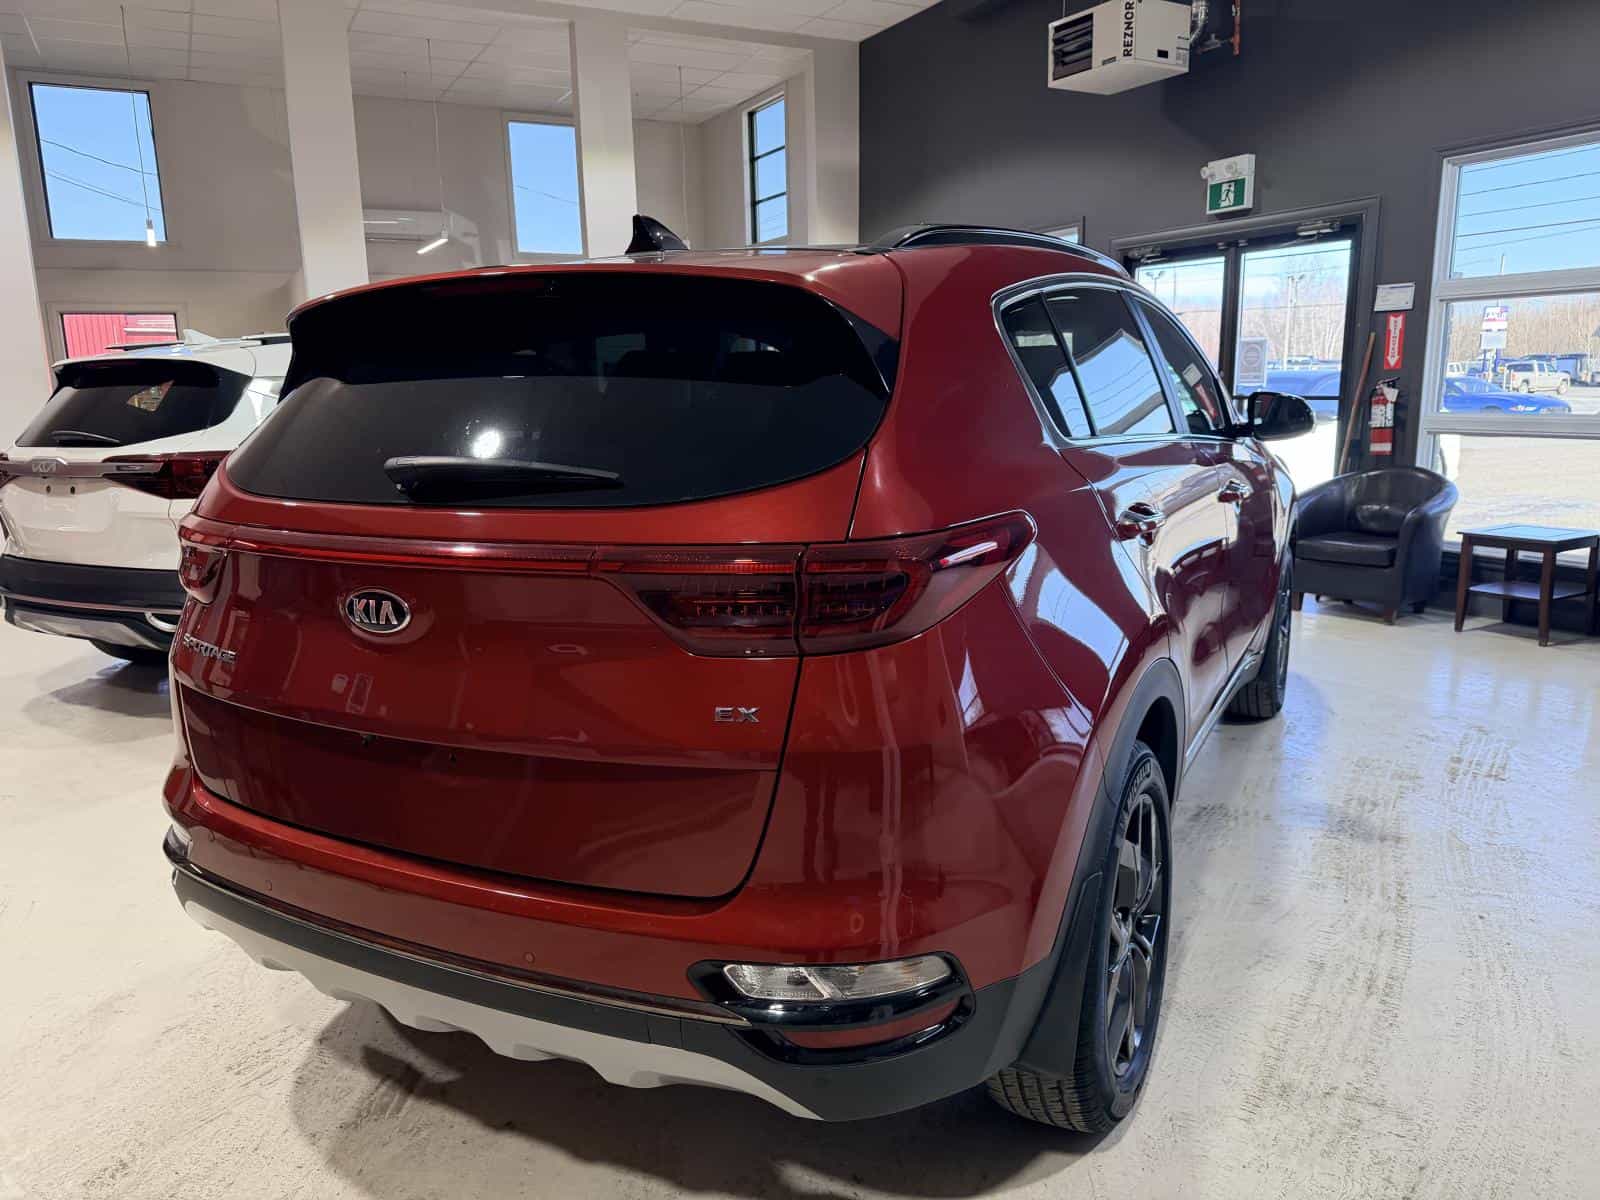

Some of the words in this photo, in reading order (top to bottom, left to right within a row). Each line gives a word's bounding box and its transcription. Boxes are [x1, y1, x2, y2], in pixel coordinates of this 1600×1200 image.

[1123, 0, 1135, 57] REZNOR
[352, 598, 399, 625] KIA
[714, 706, 760, 723] EX
